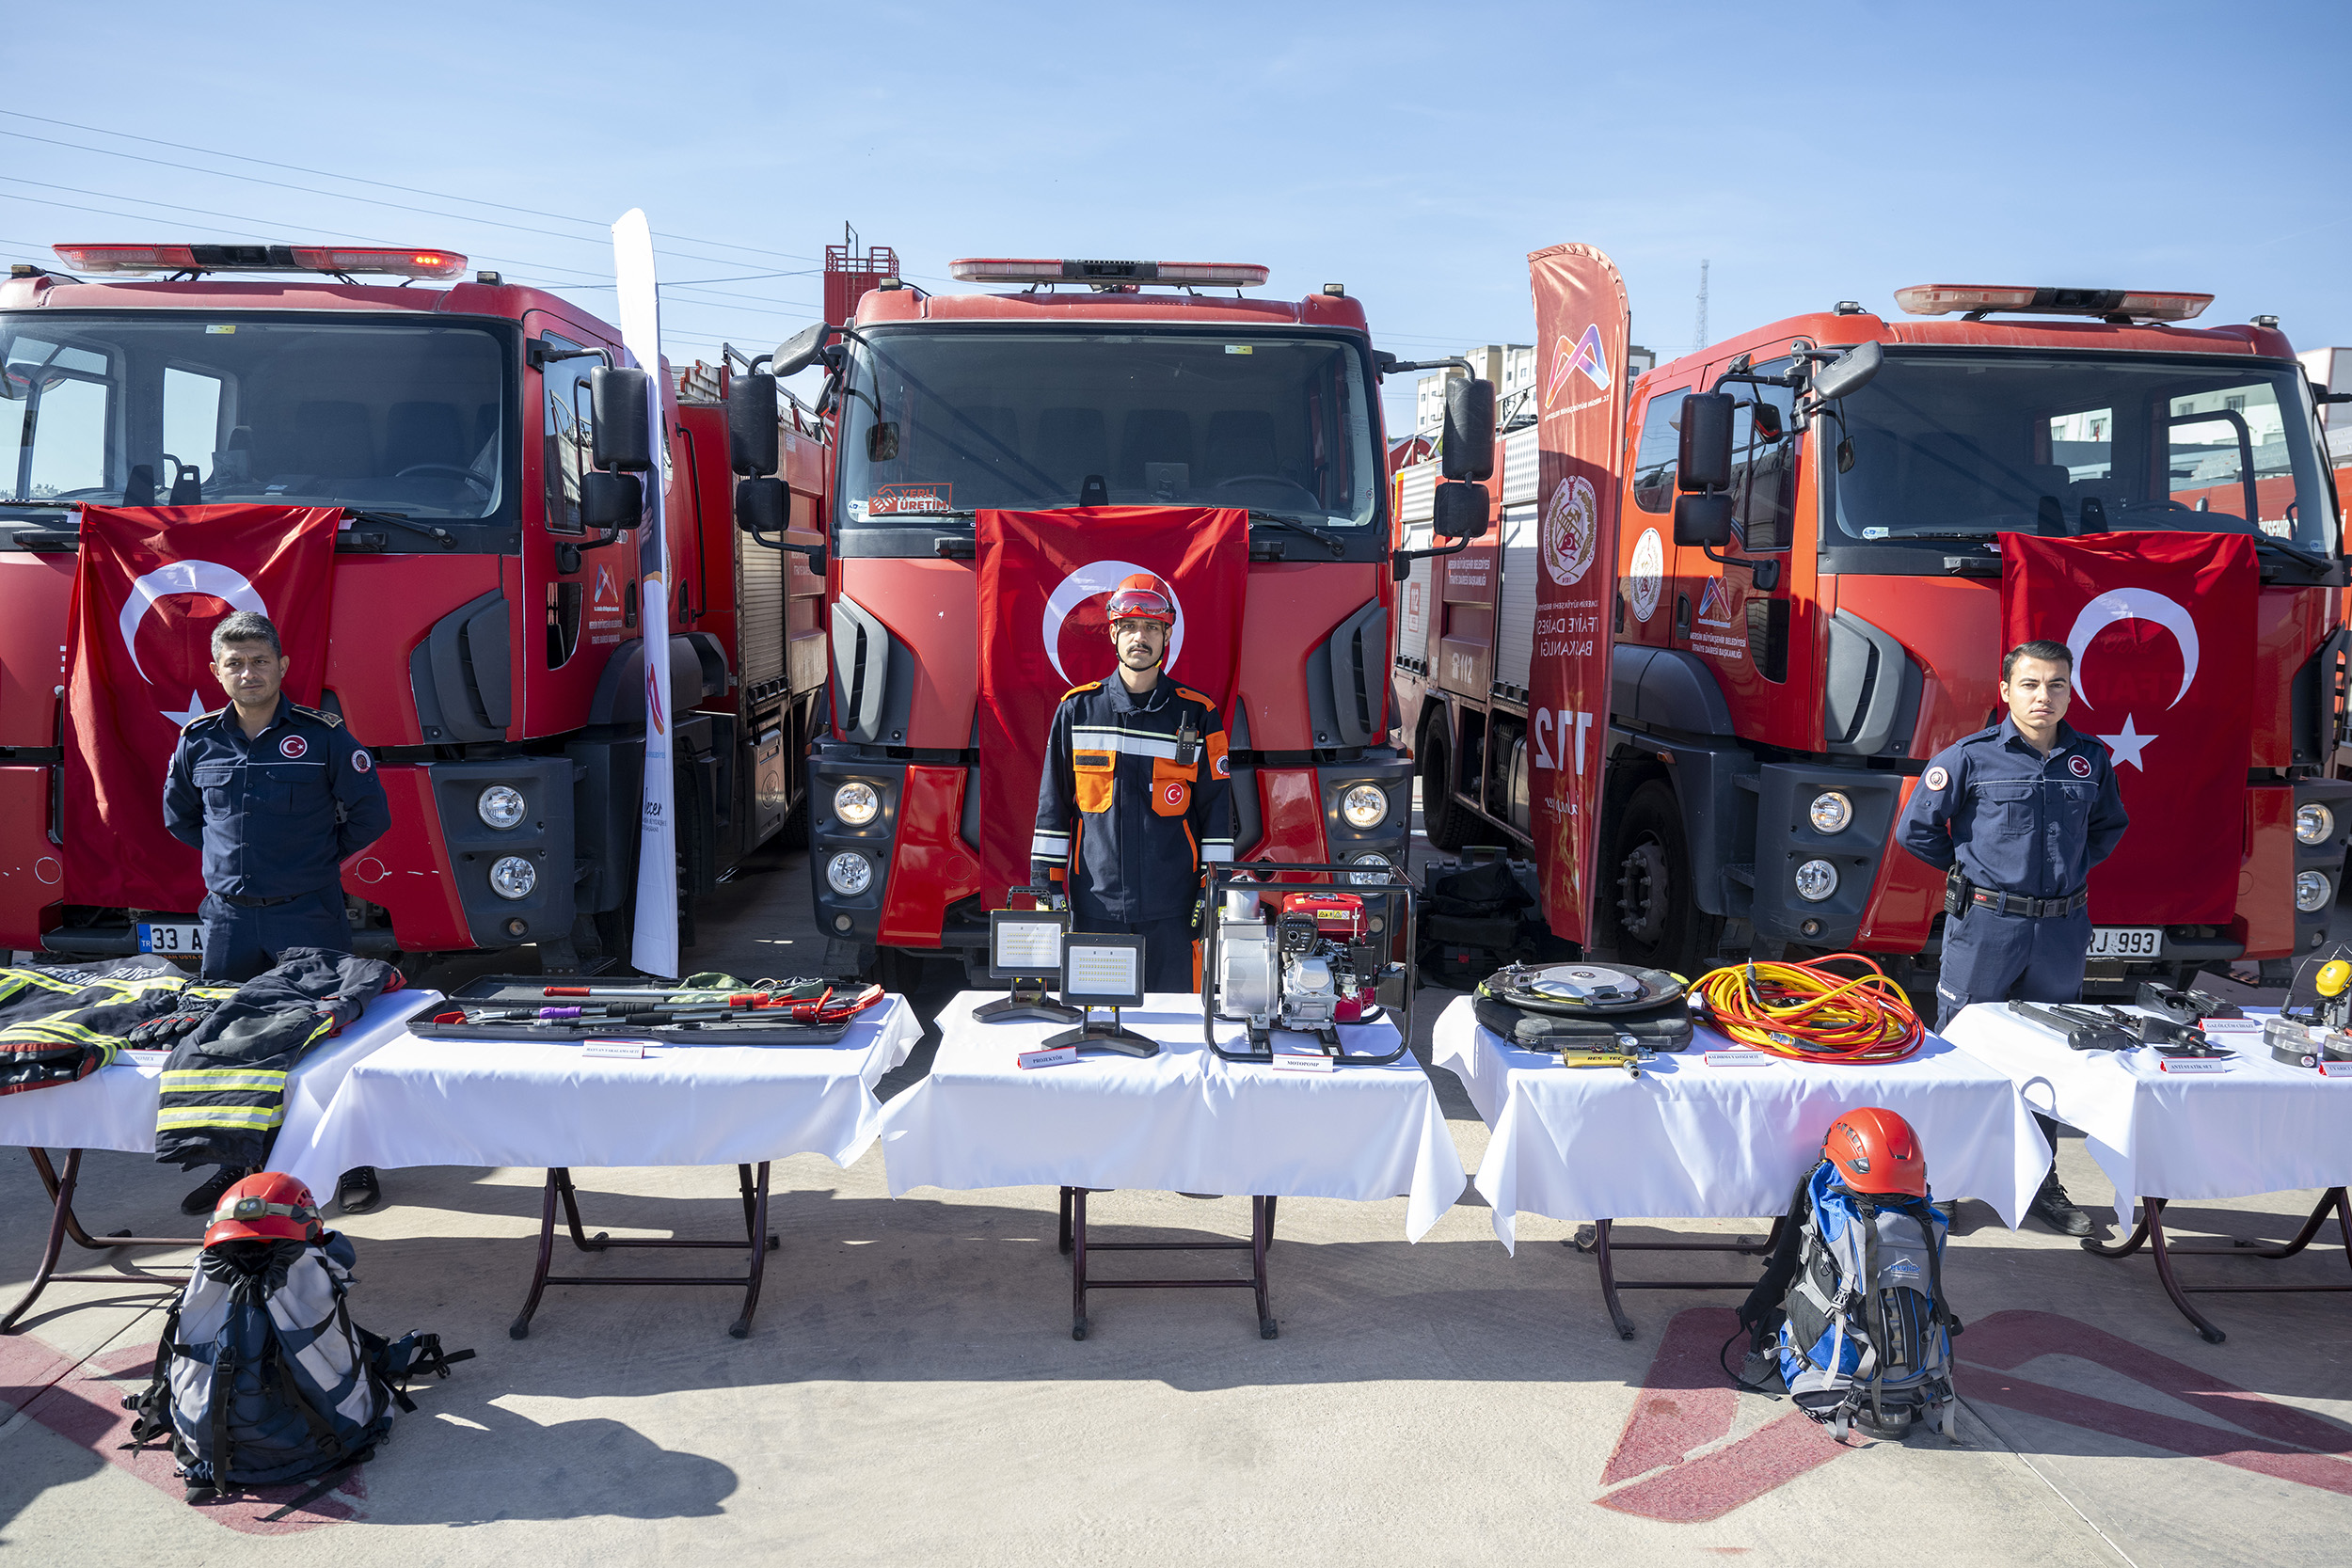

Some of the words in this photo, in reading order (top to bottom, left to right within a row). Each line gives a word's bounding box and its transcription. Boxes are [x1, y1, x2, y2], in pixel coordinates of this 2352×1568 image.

[900, 486, 937, 499] YERLİ
[899, 499, 947, 511] ÜRETİM
[1460, 655, 1473, 684] 112
[151, 928, 179, 950] 33
[192, 927, 204, 950] A
[2118, 932, 2155, 954] 993
[1032, 1054, 1064, 1064] PROJEKTÖR
